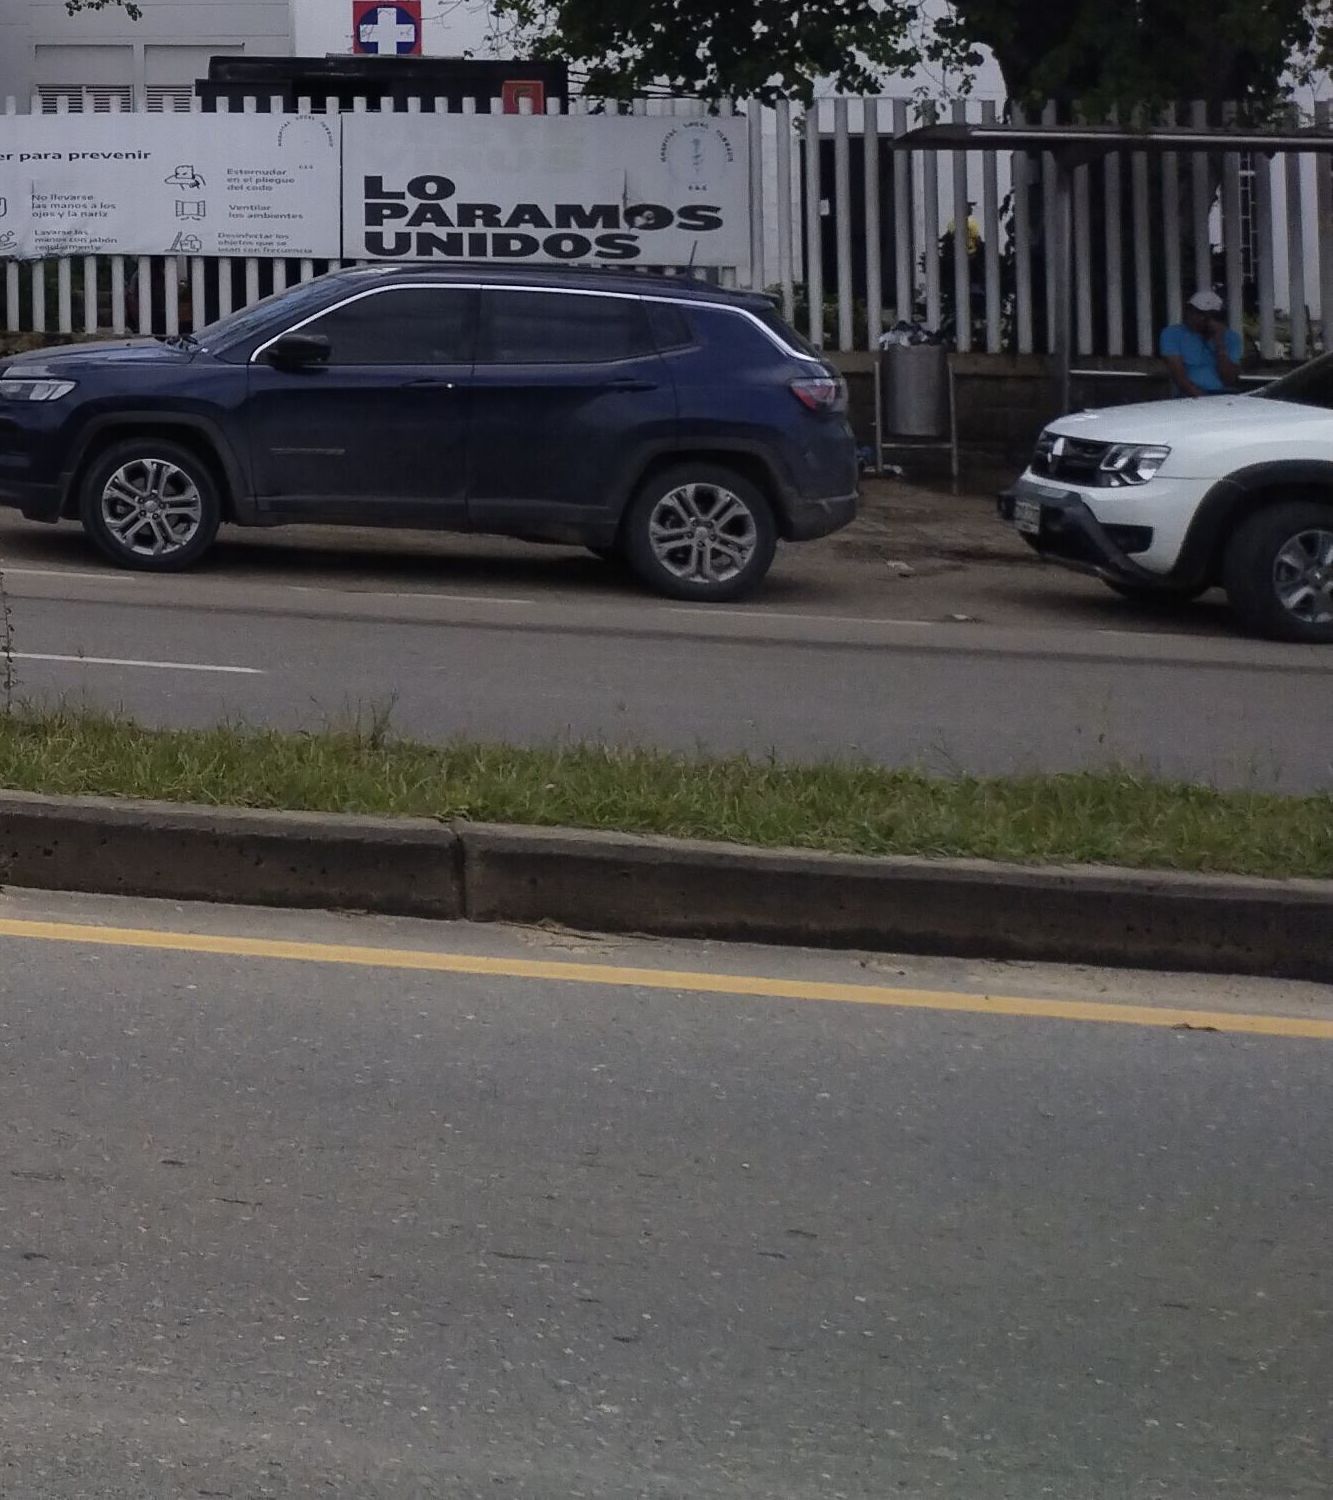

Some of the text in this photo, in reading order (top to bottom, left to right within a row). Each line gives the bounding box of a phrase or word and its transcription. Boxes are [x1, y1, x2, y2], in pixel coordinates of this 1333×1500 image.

[19, 152, 62, 162] para
[68, 150, 152, 162] prevenir
[364, 175, 456, 201] LO
[364, 202, 724, 231] PARAMOS
[364, 231, 641, 260] UNIDOS
